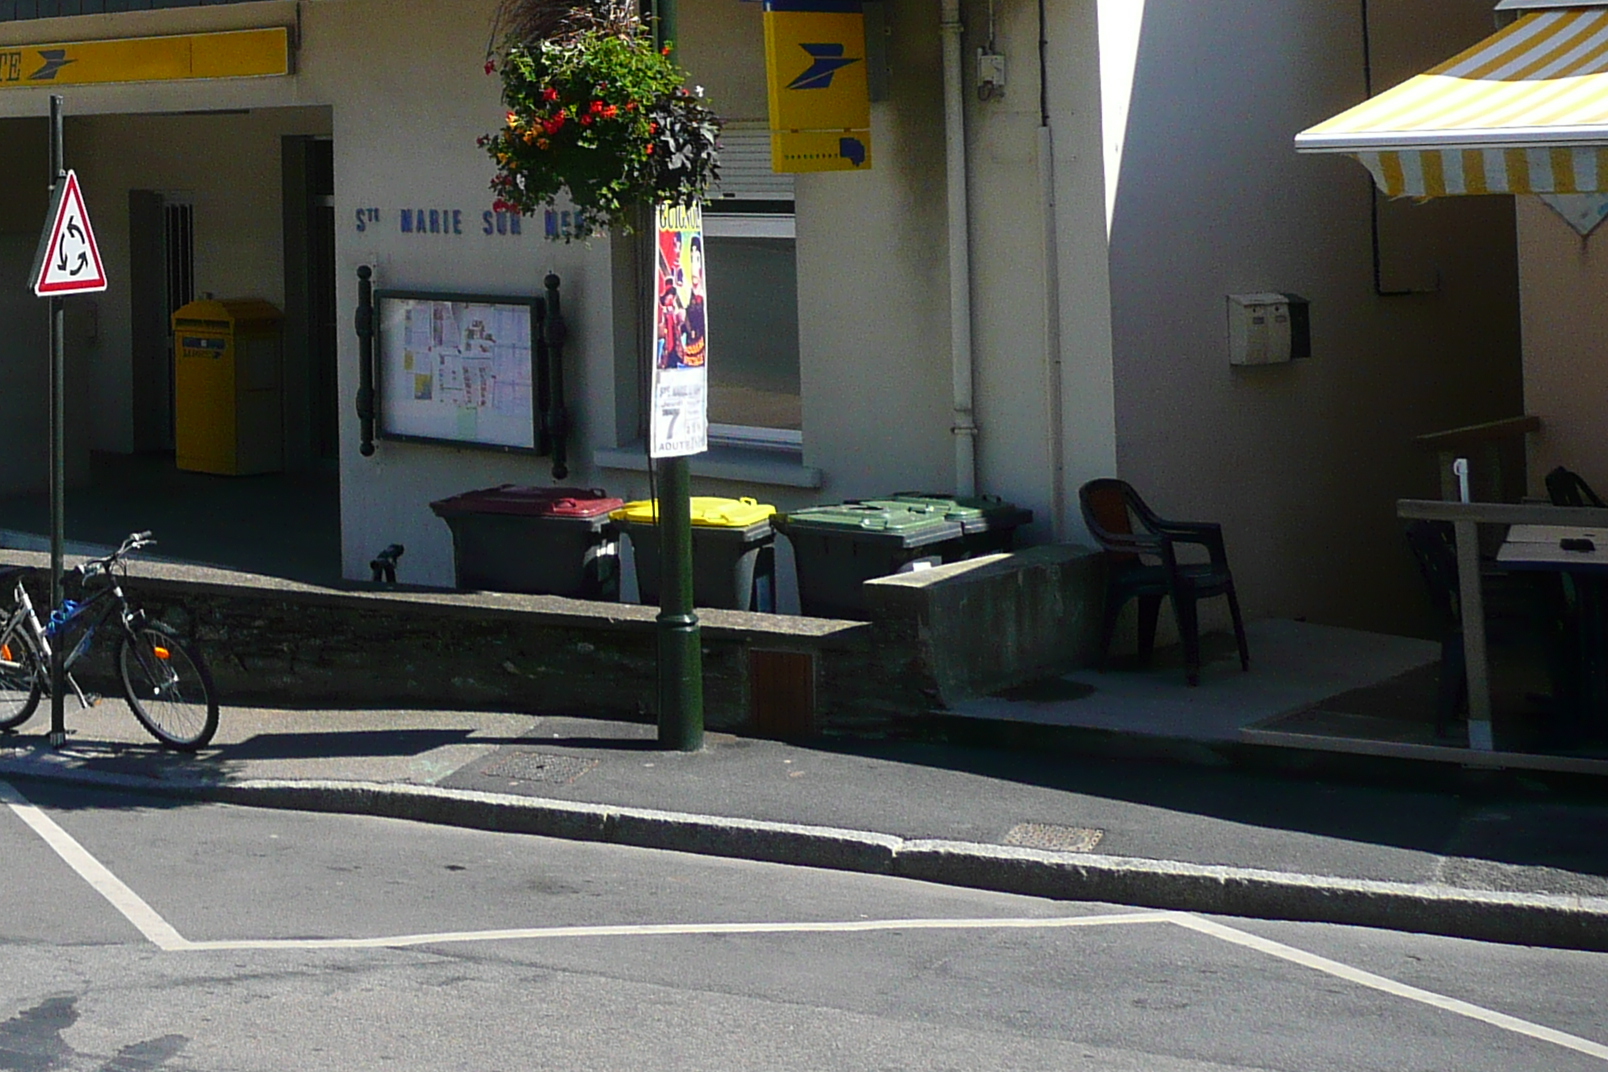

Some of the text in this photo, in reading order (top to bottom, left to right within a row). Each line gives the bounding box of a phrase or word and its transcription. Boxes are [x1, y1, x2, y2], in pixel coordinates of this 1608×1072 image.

[400, 209, 462, 234] MARIE
[482, 209, 522, 235] SUR
[662, 409, 680, 439] 7
